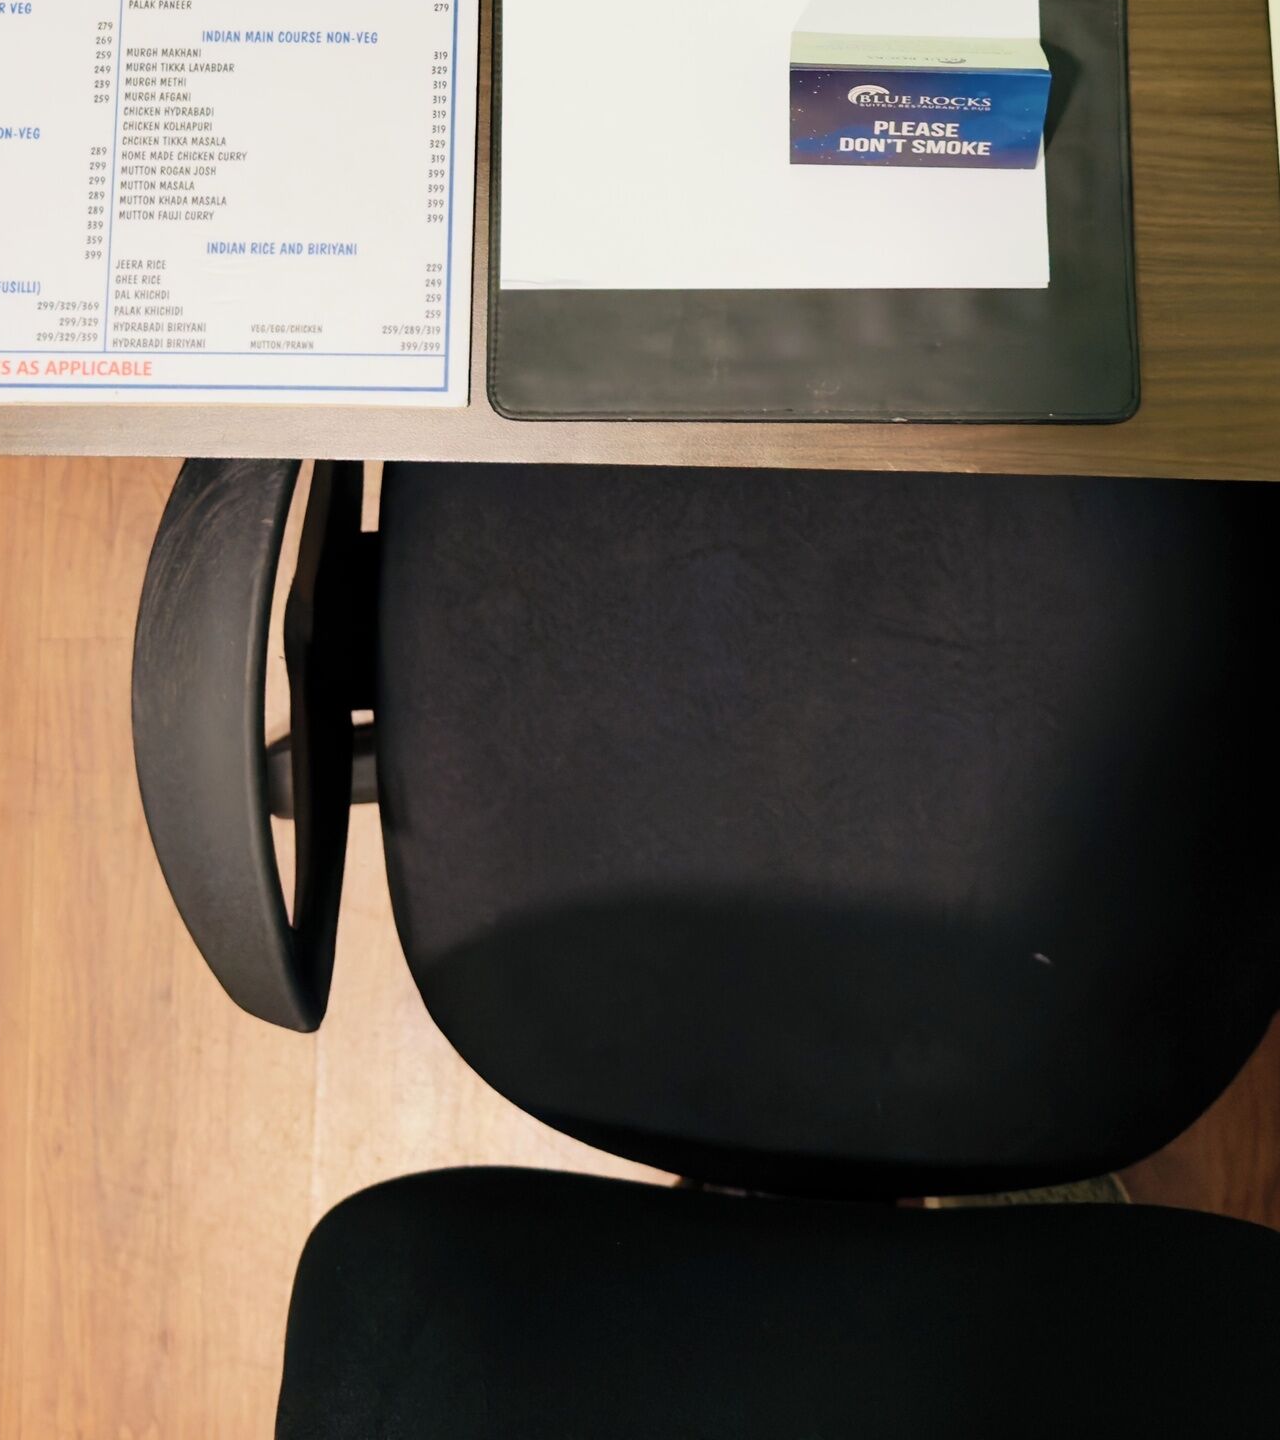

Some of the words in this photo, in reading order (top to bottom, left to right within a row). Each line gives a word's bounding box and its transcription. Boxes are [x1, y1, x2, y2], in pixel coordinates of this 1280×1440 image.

[10, 2, 32, 15] VEG
[202, 30, 241, 43] INDIAN
[245, 31, 274, 43] MAIN
[277, 31, 322, 44] COURSE
[326, 31, 378, 44] NON-VEG
[94, 65, 111, 74] 249
[125, 77, 157, 87] MURGH
[160, 77, 186, 87] METHI
[433, 80, 447, 90] 319
[860, 95, 911, 105] BLUE
[920, 96, 992, 107] ROCKS
[873, 120, 960, 138] PLEASE
[839, 137, 907, 153] DON'T
[911, 139, 992, 156] SMOKE
[121, 165, 157, 175] MUTTON
[160, 166, 191, 176] ROGAN
[193, 166, 216, 176] JOSH
[428, 169, 445, 178] 399
[88, 206, 104, 215] 289
[207, 241, 246, 254] INDIAN
[250, 242, 275, 255] RICE
[280, 242, 304, 255] AND
[308, 243, 357, 255] BIRIYANI
[16, 360, 39, 375] AS
[45, 360, 152, 377] APPLICABLE
